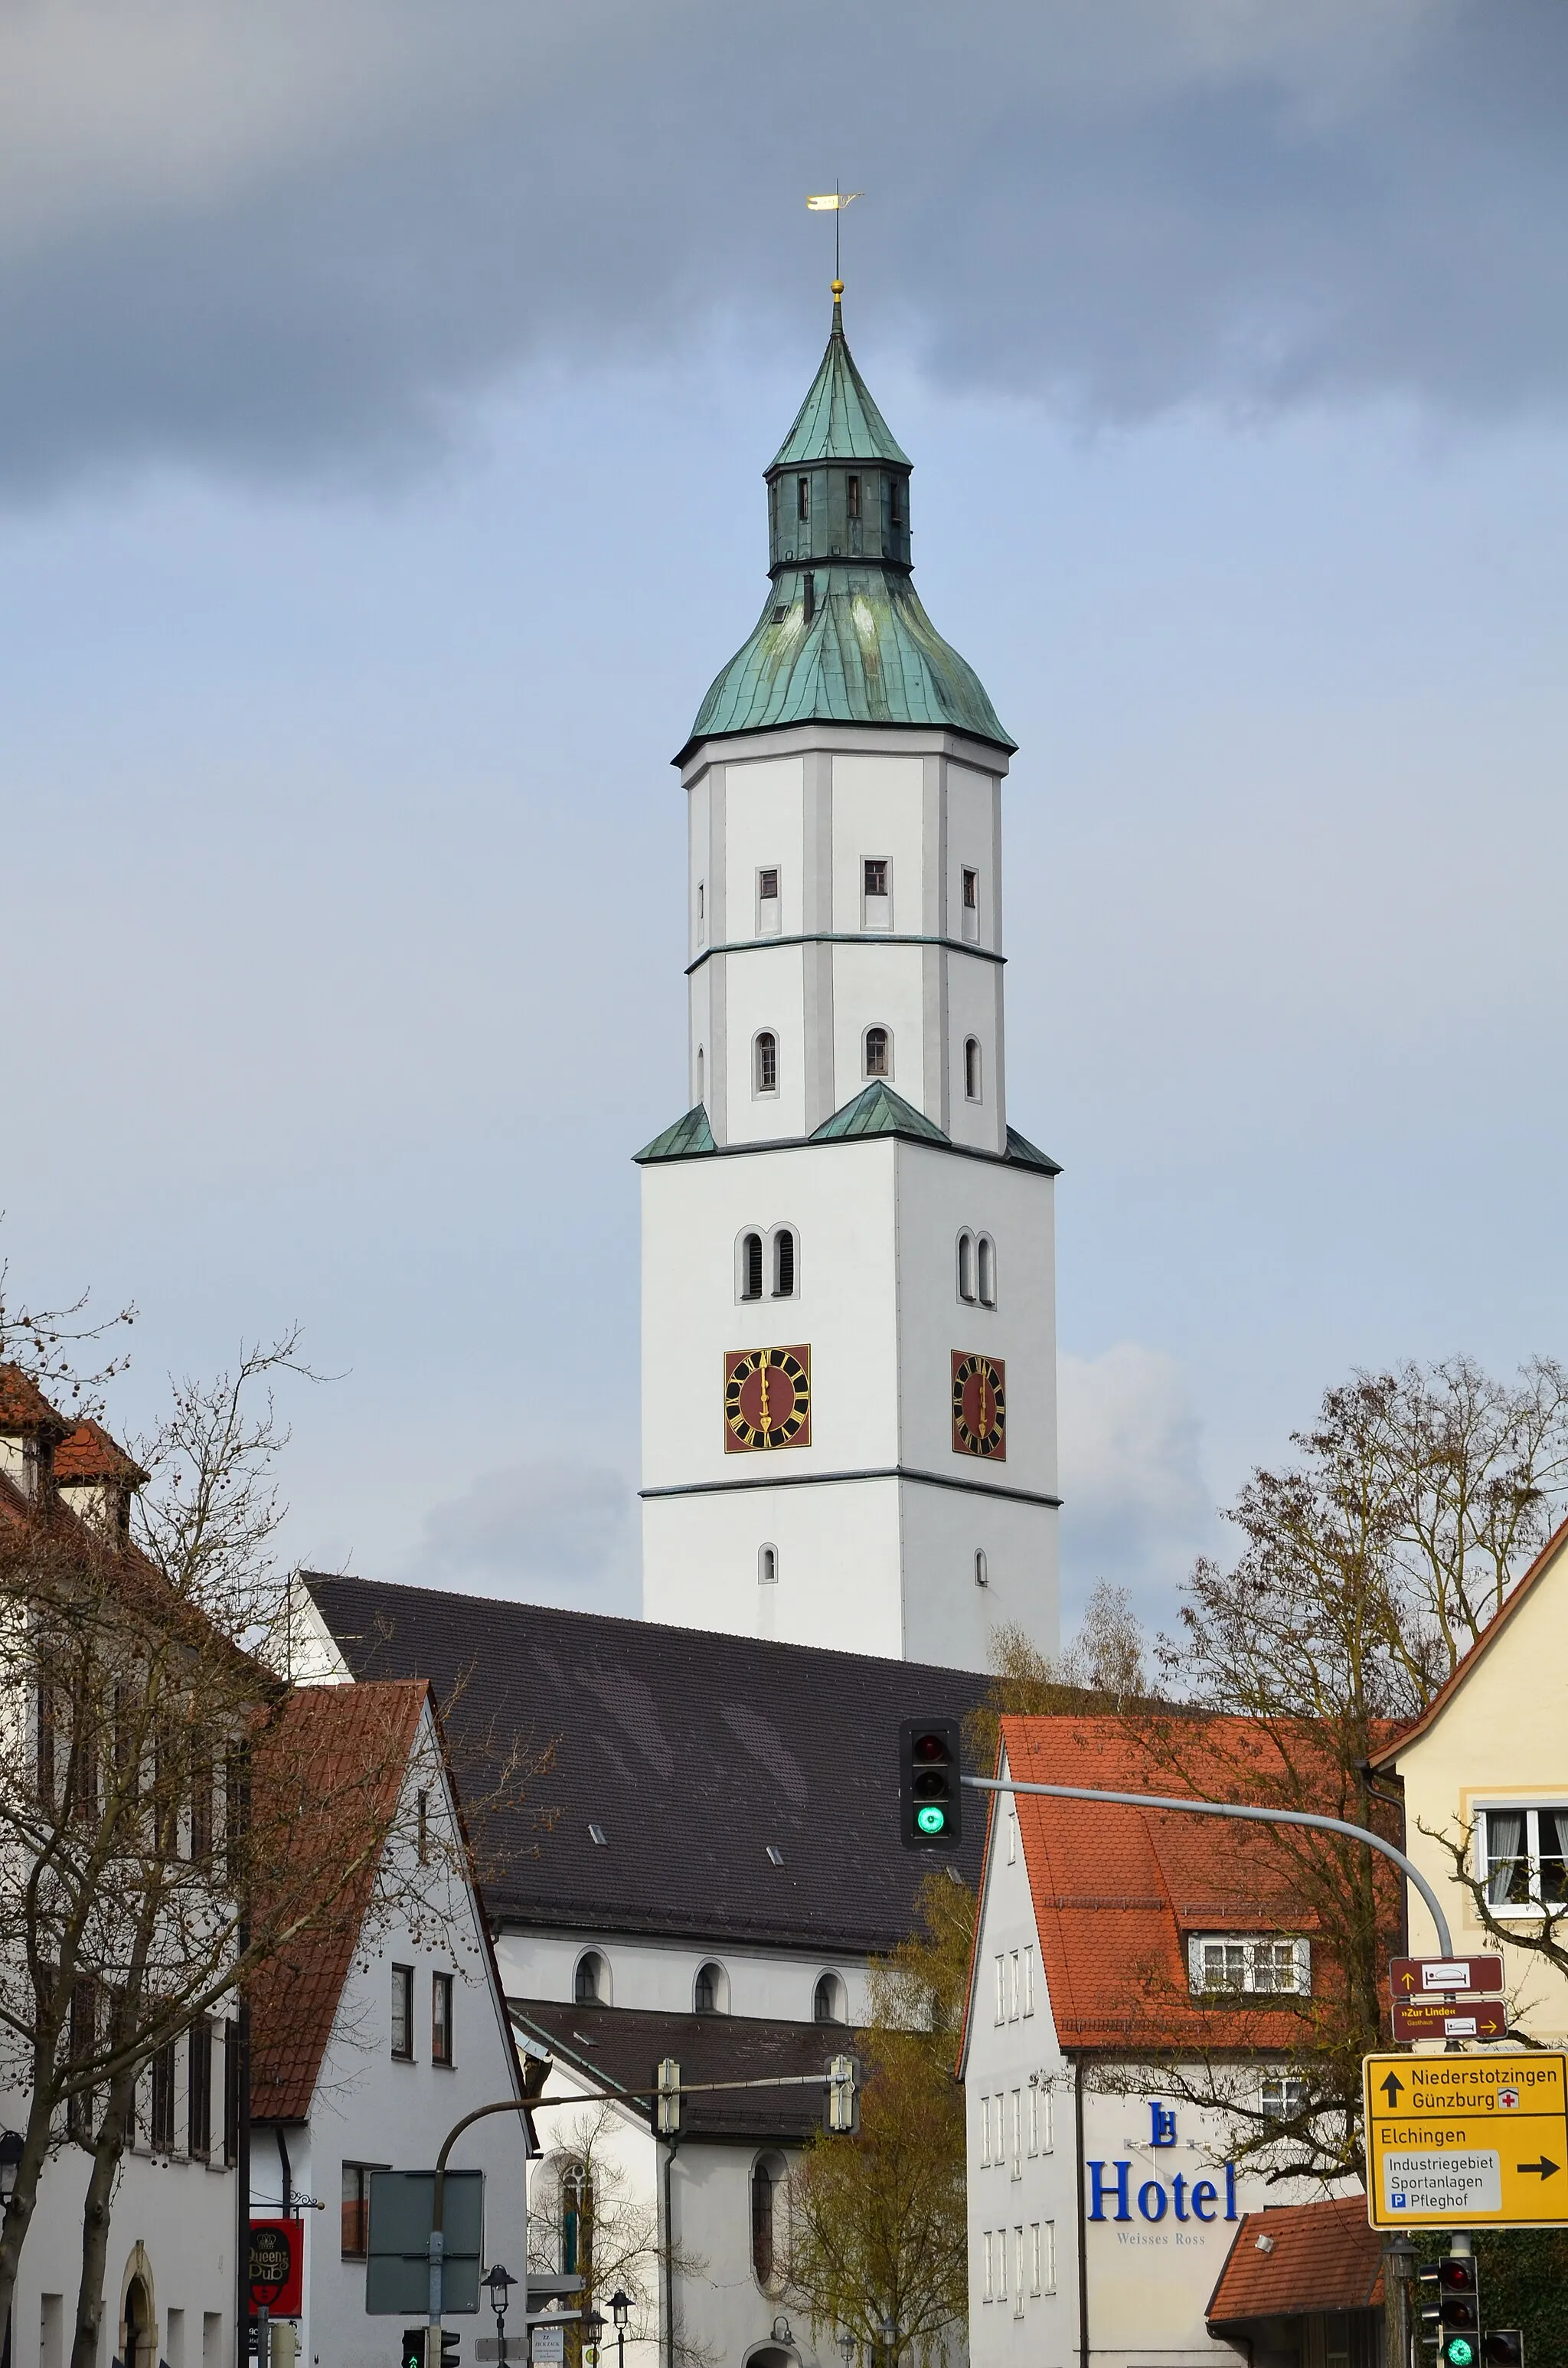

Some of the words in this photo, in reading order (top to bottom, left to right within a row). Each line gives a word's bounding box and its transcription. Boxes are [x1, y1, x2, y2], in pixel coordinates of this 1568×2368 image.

[1411, 2068, 1557, 2087] Niederstotzingen
[1413, 2092, 1494, 2111] Günzburg
[1381, 2128, 1466, 2147] Elchingen
[1389, 2156, 1494, 2175] Industriegebiet
[1086, 2160, 1239, 2222] Hotel
[1390, 2177, 1484, 2193] Sportanlagen
[1410, 2193, 1469, 2209] Pfleghof
[1117, 2232, 1168, 2245] Weisses
[1175, 2232, 1205, 2245] Ross
[249, 2264, 283, 2281] Pub
